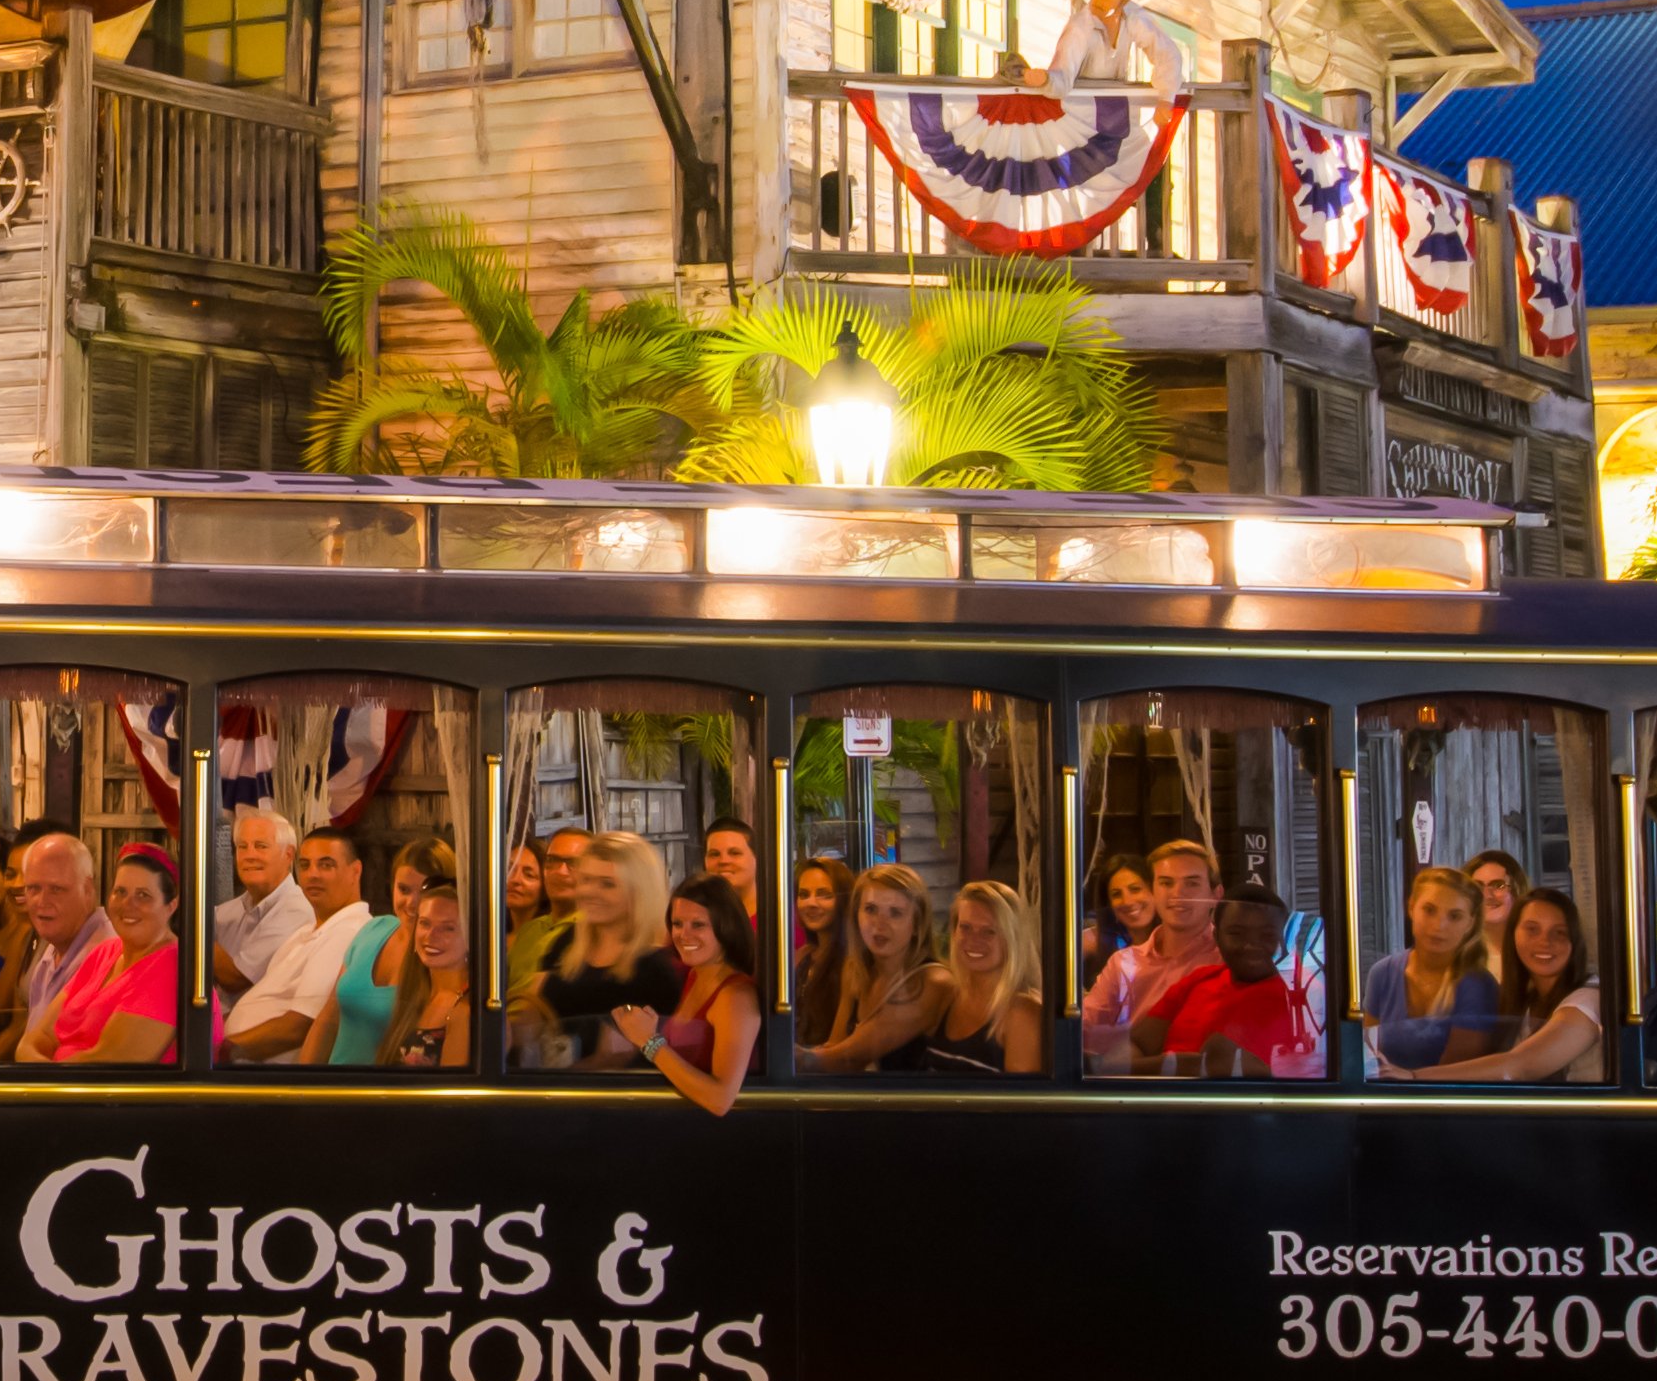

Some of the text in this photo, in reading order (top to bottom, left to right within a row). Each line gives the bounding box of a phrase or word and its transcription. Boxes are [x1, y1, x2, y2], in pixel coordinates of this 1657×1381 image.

[1244, 833, 1267, 851] NO
[19, 1144, 674, 1306] GHOSTS &
[1268, 1230, 1584, 1279] Reservations
